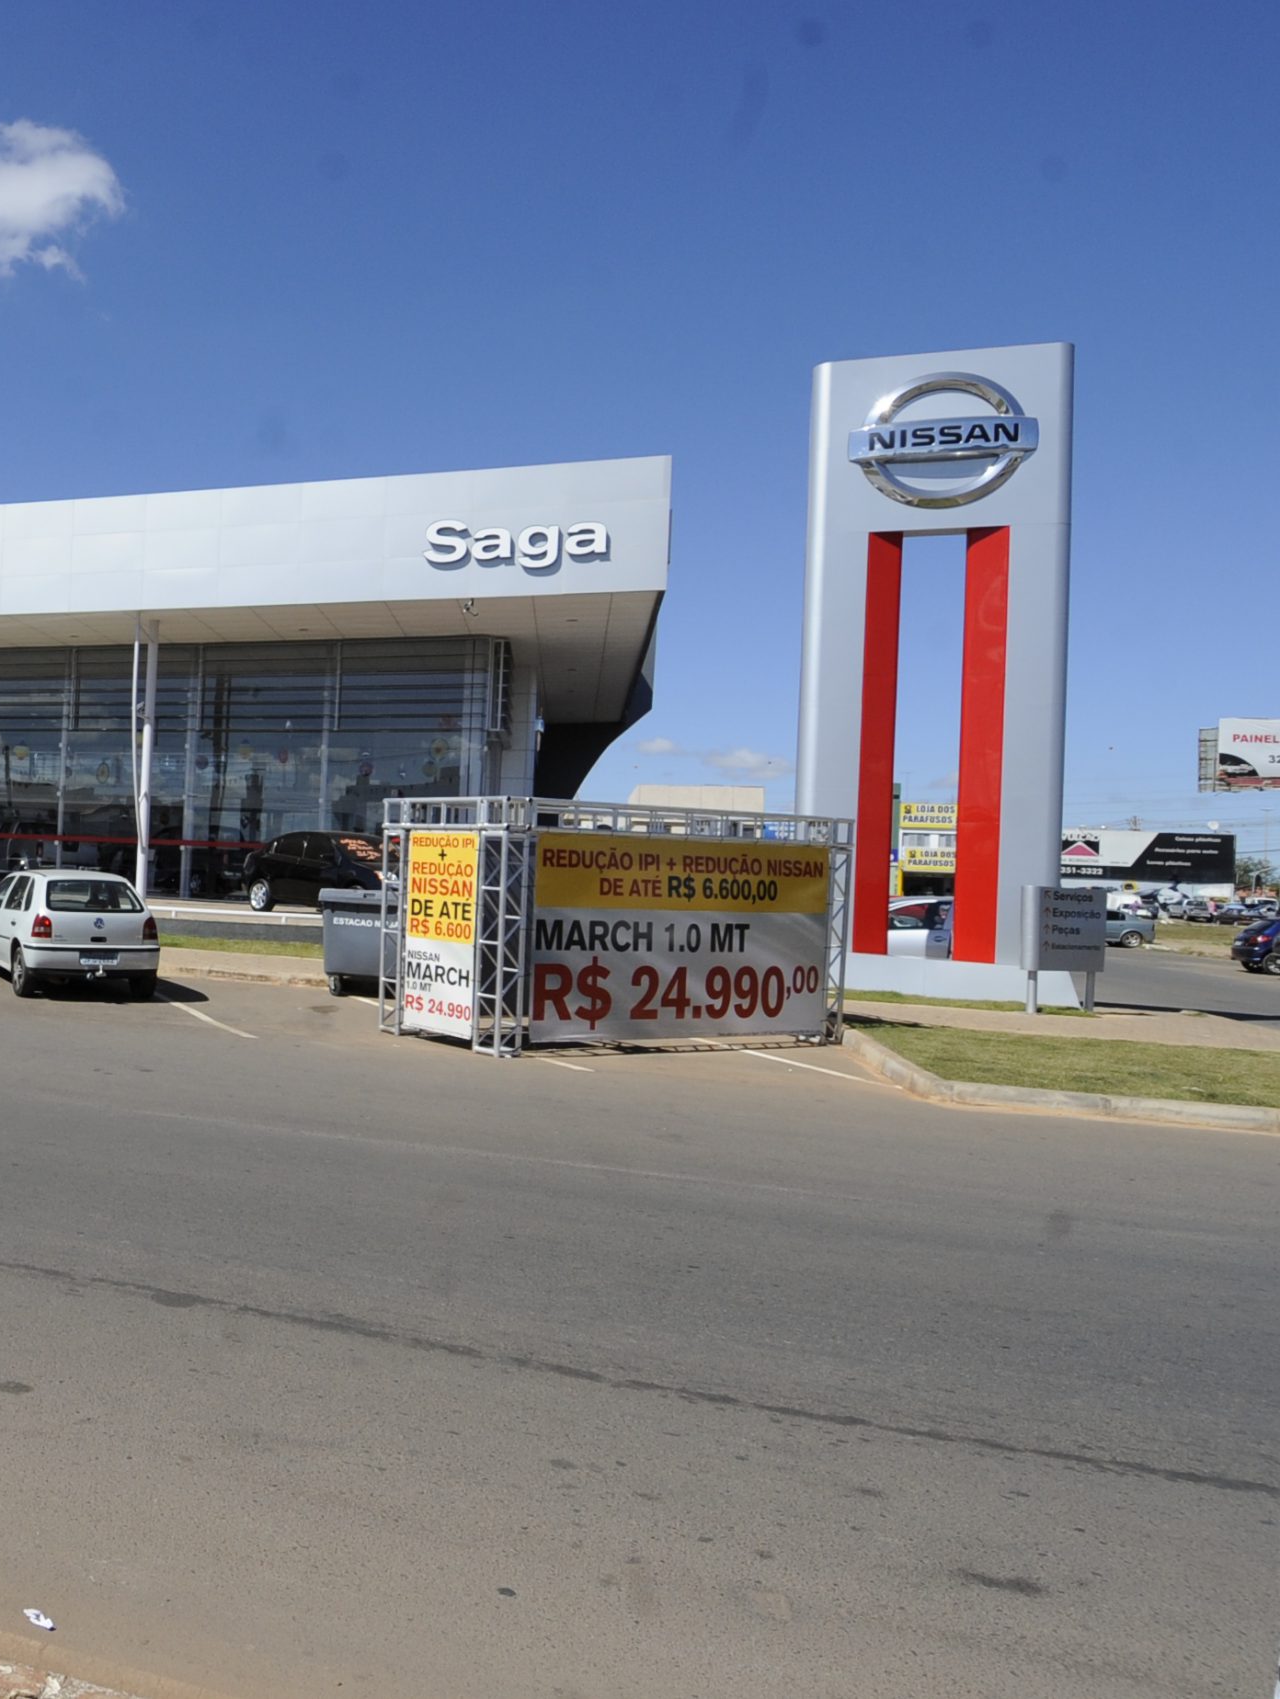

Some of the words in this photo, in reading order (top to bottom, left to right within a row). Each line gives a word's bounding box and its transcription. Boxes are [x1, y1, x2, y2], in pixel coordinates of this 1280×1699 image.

[869, 422, 1020, 451] NISSAN
[423, 519, 611, 577] Saga
[1232, 733, 1280, 743] PAINEL
[937, 805, 955, 813] DOS
[412, 835, 459, 849] REDUÇÃO
[462, 837, 475, 849] IPI
[412, 860, 474, 878] REDUÇÃO
[542, 847, 632, 873] REDUÇÃO
[639, 853, 661, 871] IPI
[683, 854, 762, 878] REDUÇÃO
[767, 859, 824, 878] NISSAN
[411, 877, 473, 899] NISSAN
[599, 878, 625, 896] DE
[629, 875, 662, 898] ATÉ
[667, 874, 696, 902] R$
[702, 879, 778, 905] 6.600,00
[1053, 891, 1093, 904] Serviços
[411, 898, 433, 918] DE
[439, 898, 472, 922] ATÉ
[1052, 908, 1102, 921] Exposição
[410, 917, 429, 936] R$
[434, 921, 471, 939] 6.600
[535, 919, 653, 952] MARCH
[664, 922, 701, 953] 1.0
[710, 923, 750, 953] MT
[1052, 925, 1081, 937] Peças
[407, 949, 440, 962] NISSAN
[406, 961, 470, 988] MARCH
[406, 980, 419, 990] 1.0
[419, 983, 432, 993] MT
[532, 956, 612, 1031] R$
[630, 965, 819, 1020] 24.990,00
[405, 994, 424, 1011] R$
[428, 998, 471, 1021] 24.990
